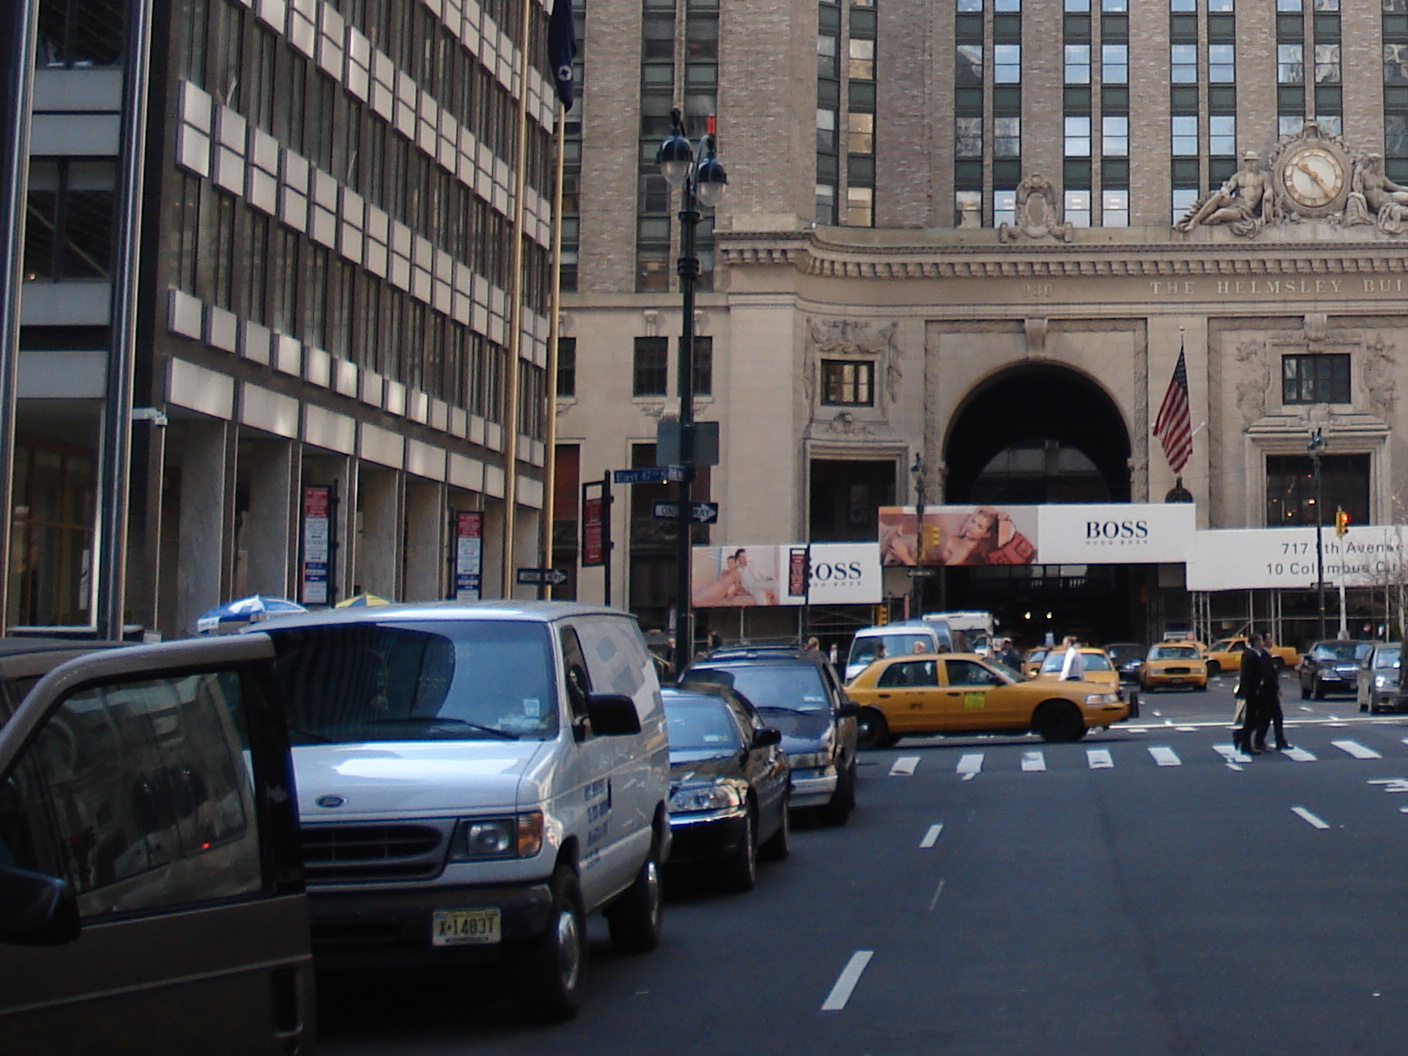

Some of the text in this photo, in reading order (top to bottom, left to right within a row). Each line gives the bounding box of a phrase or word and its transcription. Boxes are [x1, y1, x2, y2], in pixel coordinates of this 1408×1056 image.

[1150, 281, 1195, 294] THE
[1217, 279, 1343, 294] HELMSLEY
[1086, 520, 1148, 539] BOSS
[1281, 543, 1308, 555] 717
[1316, 542, 1339, 555] th
[807, 561, 862, 581] OSS
[1266, 563, 1284, 575] 10
